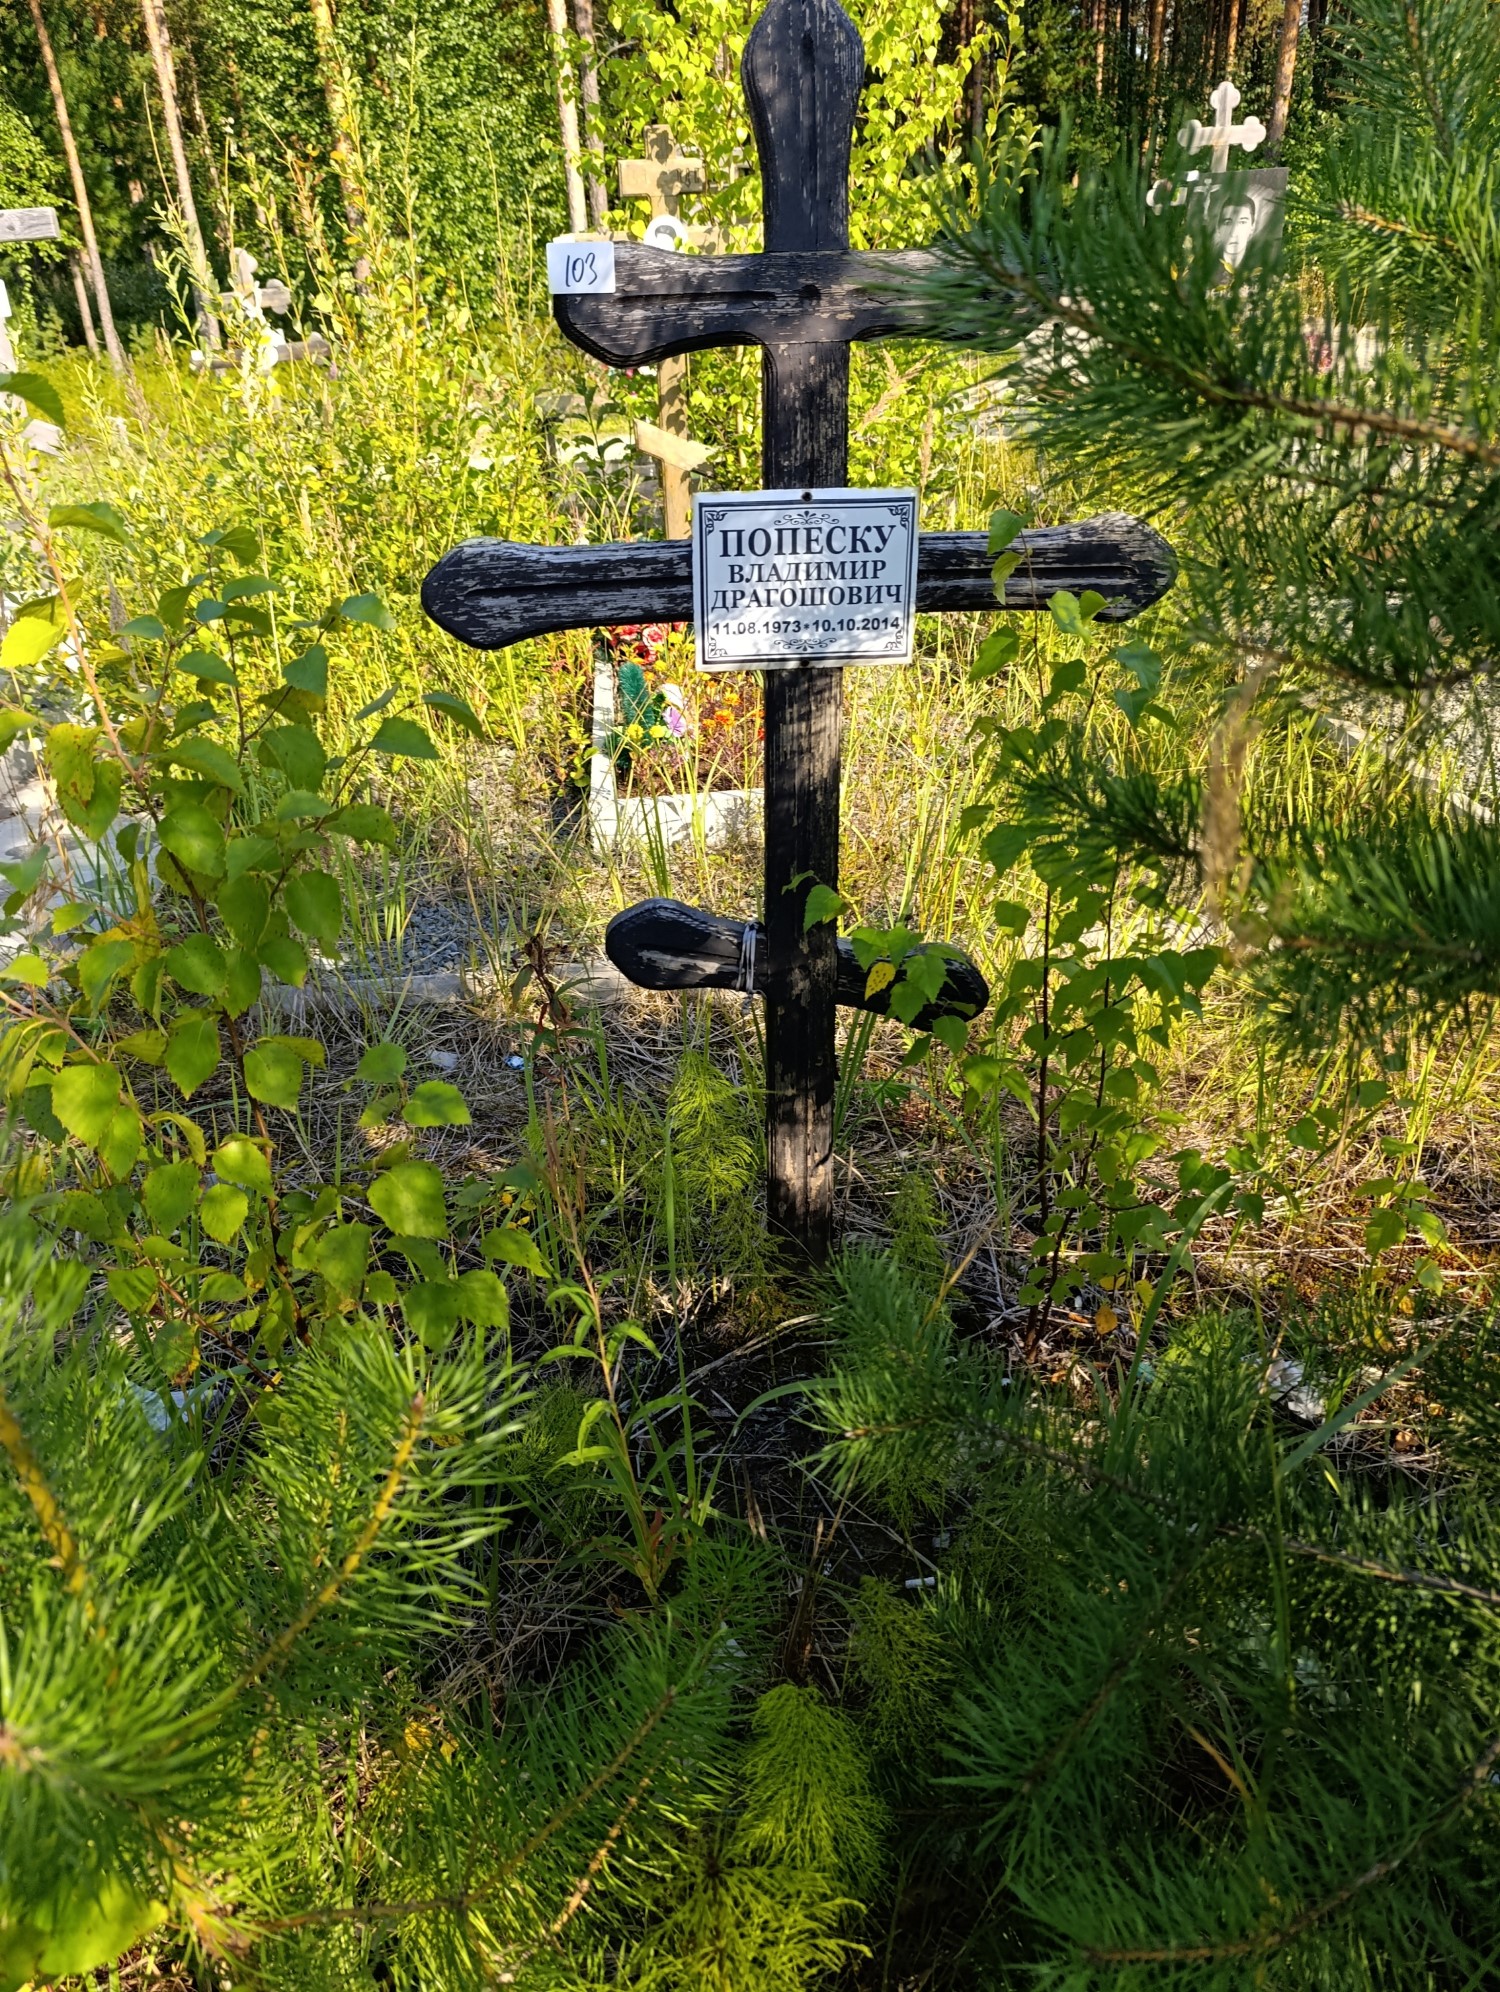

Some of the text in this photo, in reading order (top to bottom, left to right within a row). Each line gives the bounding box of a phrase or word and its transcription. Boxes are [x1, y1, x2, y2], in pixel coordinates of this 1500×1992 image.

[565, 252, 598, 287] 103
[719, 525, 896, 558] ПОПЕСКУ
[728, 560, 887, 585] ВЛАДИМИР
[711, 584, 903, 613] ДРАГОШОВИЧ
